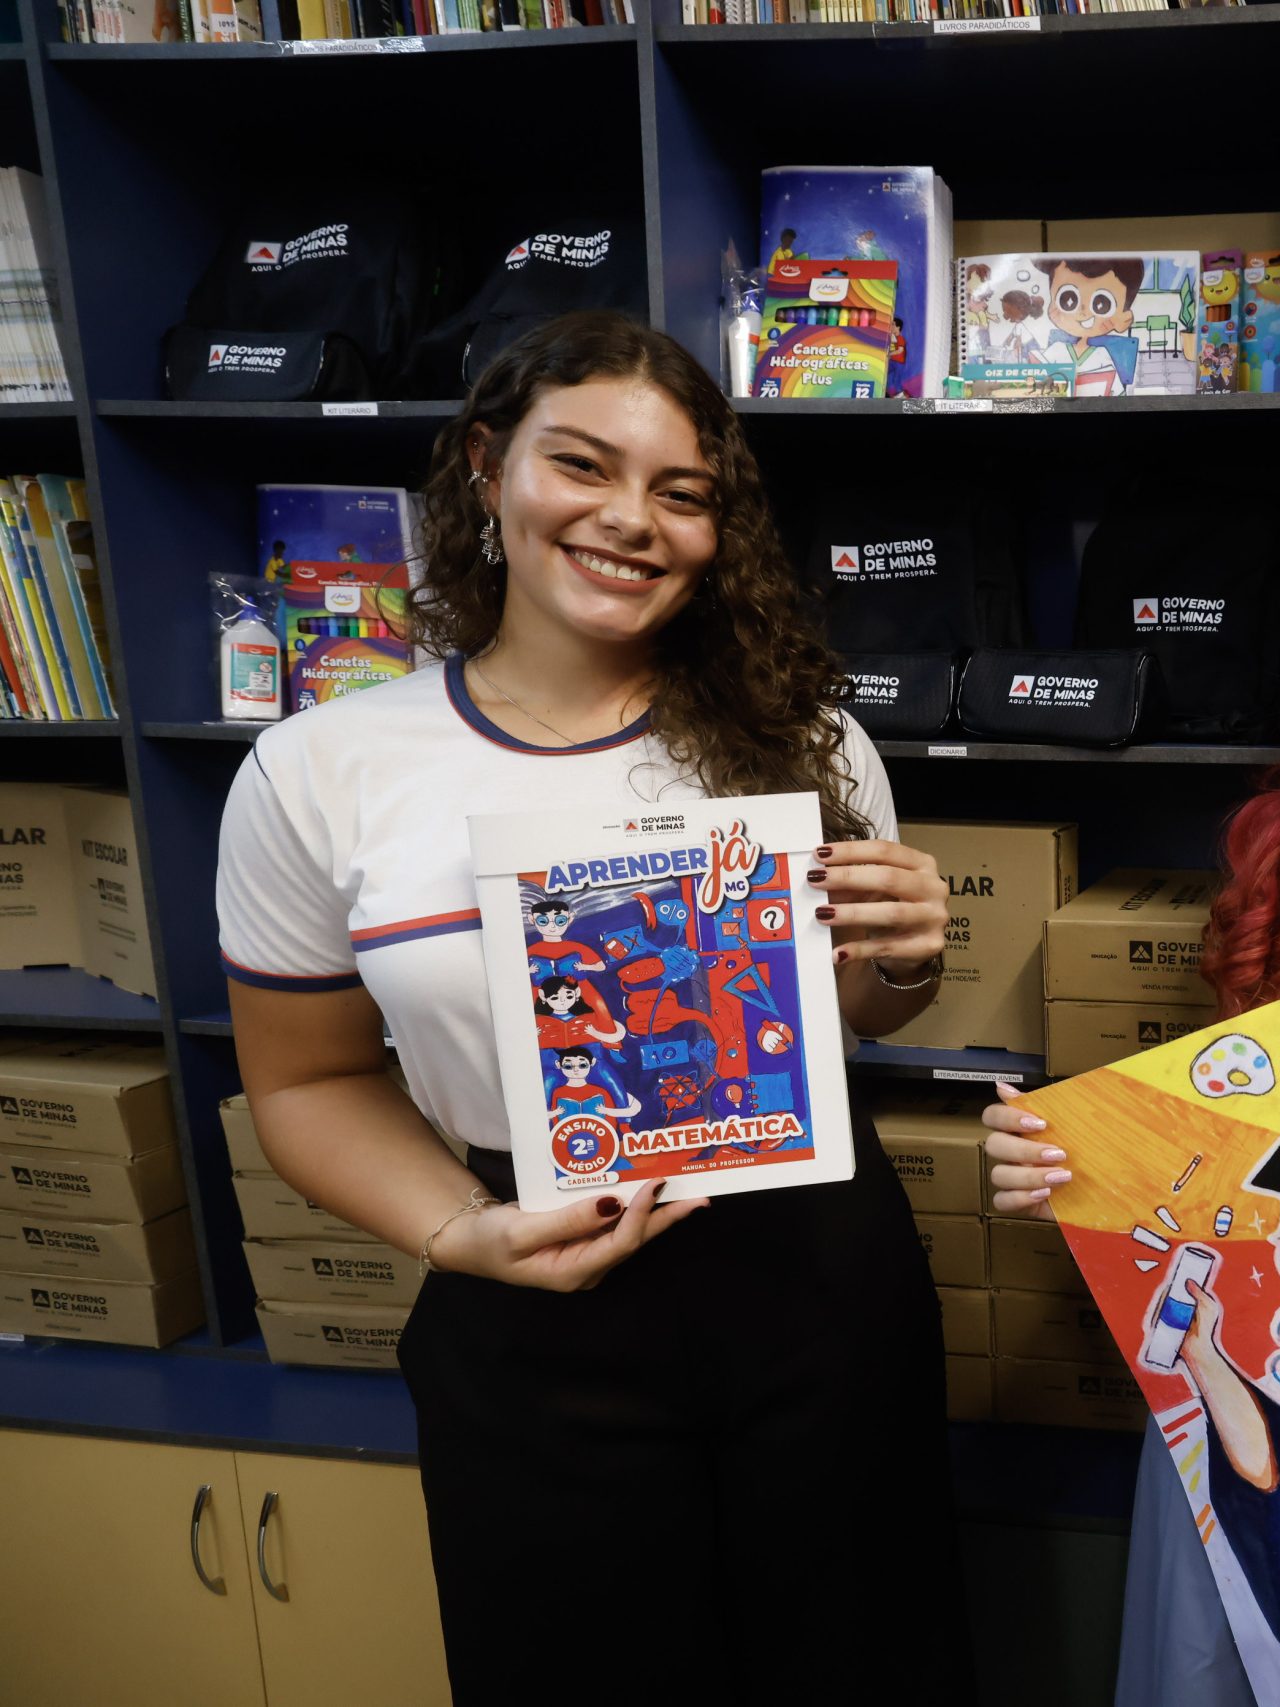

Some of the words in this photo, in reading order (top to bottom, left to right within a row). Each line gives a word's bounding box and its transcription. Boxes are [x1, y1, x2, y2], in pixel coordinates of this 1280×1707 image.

[969, 19, 1030, 29] PARADIDÁTICOS
[285, 224, 349, 250] GOVERNO
[535, 230, 611, 247] GOVERNO
[283, 248, 299, 262] DE
[301, 234, 348, 253] MINAS
[531, 242, 556, 254] DE
[562, 242, 609, 260] MINAS
[229, 345, 286, 357] GOVERNO
[793, 343, 849, 356] Canetas
[224, 355, 240, 365] DE
[242, 357, 282, 368] MINAS
[770, 356, 869, 371] Hidrográficas
[802, 372, 832, 385] Plus
[759, 387, 779, 398] 70
[855, 388, 870, 399] 12
[864, 538, 933, 556] GOVERNO
[865, 559, 885, 572] DE
[889, 553, 936, 570] MINAS
[1162, 597, 1225, 610] GOVERNO
[1163, 611, 1177, 623] DE
[1180, 611, 1222, 624] MINAS
[320, 656, 371, 668] Canetas
[302, 668, 392, 681] Hidrográficas
[844, 674, 899, 686] VERNO
[1037, 676, 1098, 688] GOVERNO
[1034, 688, 1052, 699] DE
[1054, 690, 1095, 700] MINAS
[641, 815, 684, 824] GOVERNO
[642, 824, 653, 832] DE
[656, 822, 685, 831] MINAS
[547, 847, 708, 890] APRENDER
[703, 821, 756, 908] já
[725, 880, 746, 892] MG
[1158, 955, 1176, 965] DE
[934, 1071, 970, 1080] LITERATURA
[20, 1099, 73, 1112] GOVERNO
[23, 1109, 37, 1118] DE
[41, 1111, 77, 1123] MINAS
[557, 1121, 605, 1141] ENSINO
[627, 1116, 799, 1152] MATEMÁTICA
[567, 1156, 605, 1171] MÉDIO
[682, 1164, 705, 1172] MANUAL
[720, 1158, 755, 1167] PROFESSOR
[32, 1169, 88, 1183] GOVERNO
[568, 1176, 602, 1185] CADERNO
[603, 1174, 608, 1182] 1
[36, 1179, 51, 1188] DE
[53, 1181, 91, 1192] MINAS
[335, 1259, 392, 1270] GOVERNO
[338, 1268, 352, 1277] DE
[356, 1271, 395, 1280] MINAS
[52, 1291, 106, 1304] GOVERNO
[53, 1302, 68, 1310] DE
[72, 1304, 108, 1315] MINAS
[347, 1335, 362, 1344] DE
[366, 1337, 400, 1347] MINA
